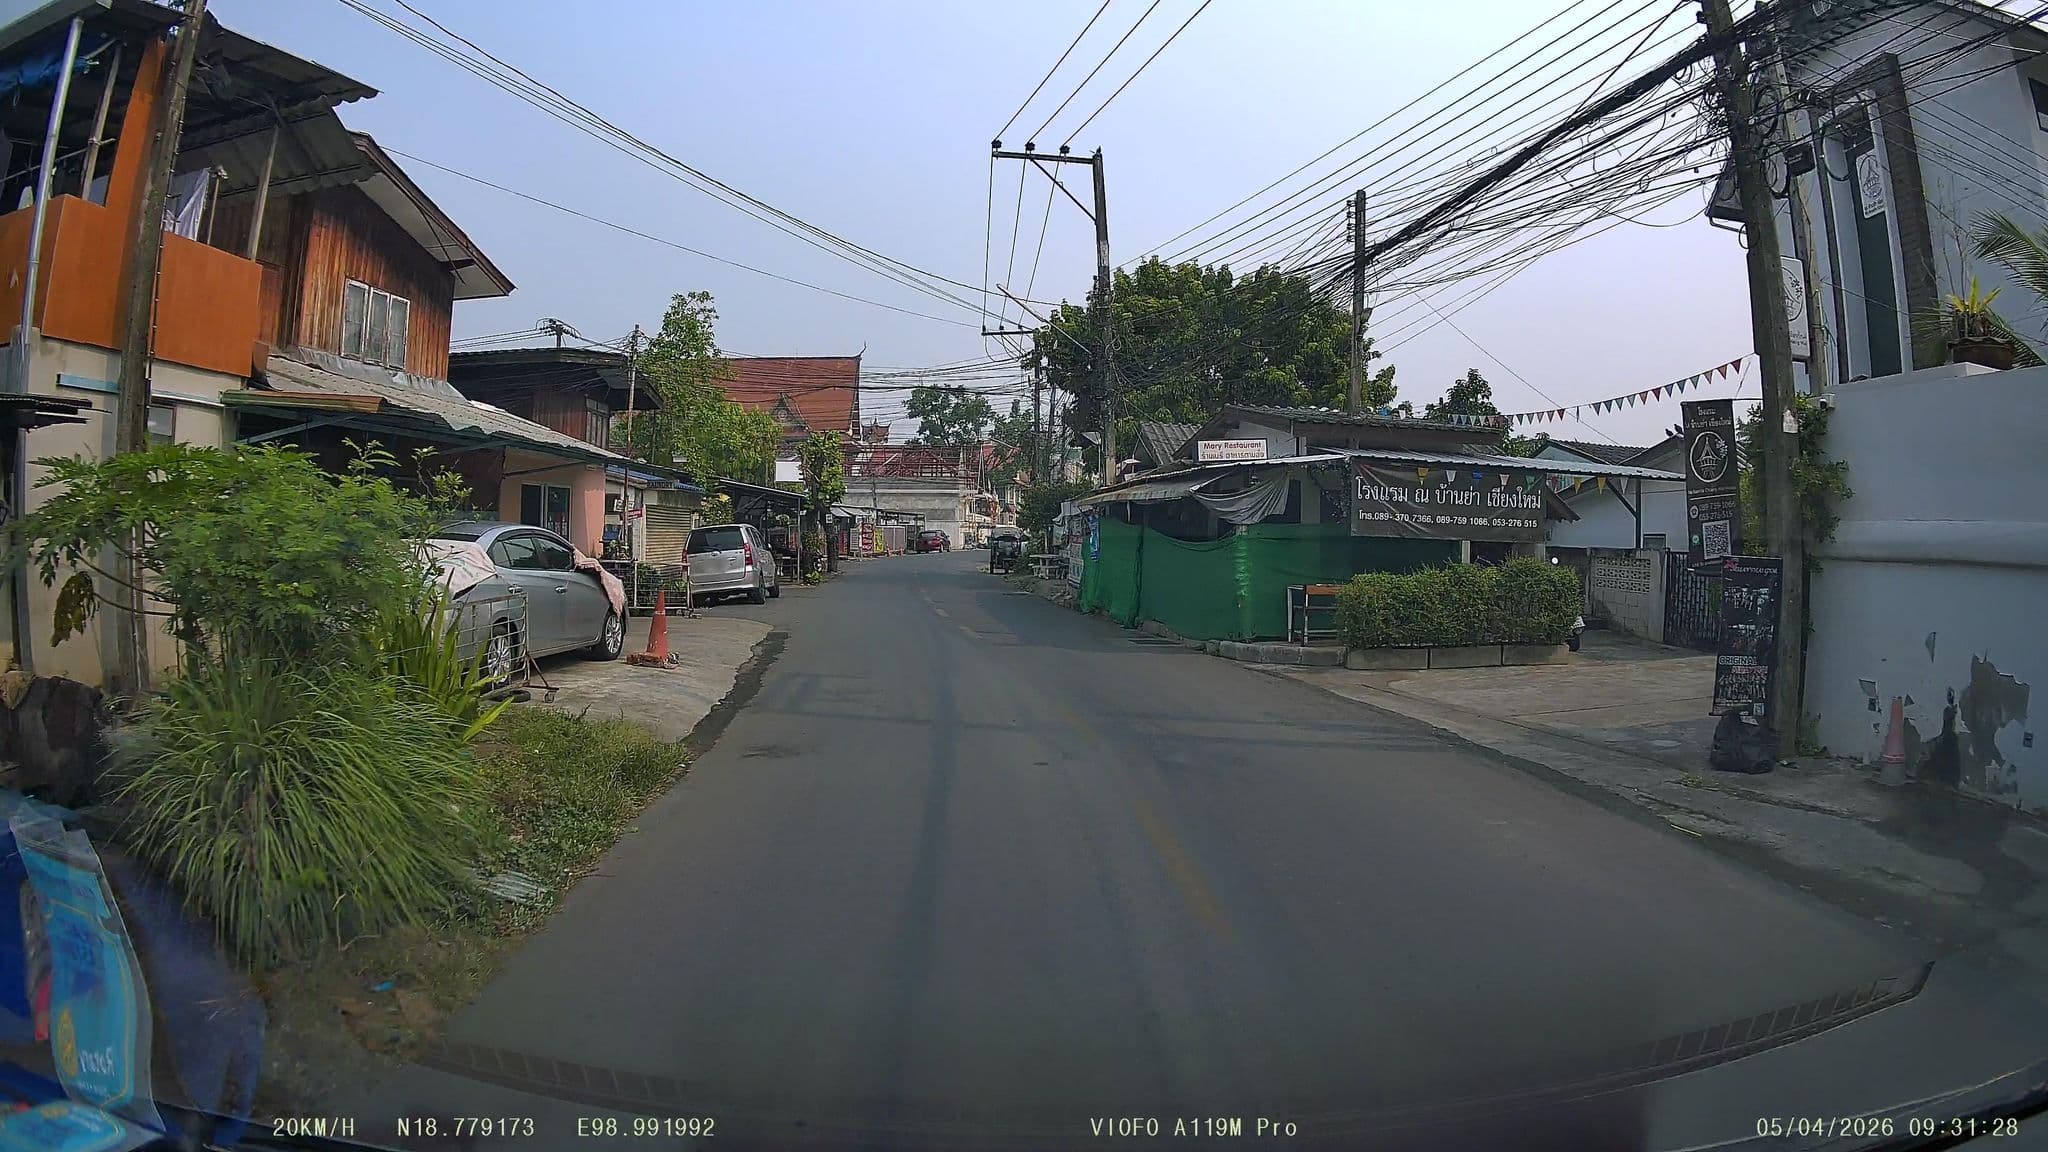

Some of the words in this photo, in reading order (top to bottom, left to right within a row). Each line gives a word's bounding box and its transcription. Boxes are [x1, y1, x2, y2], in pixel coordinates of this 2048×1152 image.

[1203, 442, 1223, 451] Mary
[1224, 441, 1261, 449] Restaurant
[1354, 475, 1409, 503] โรงแรม
[1415, 488, 1430, 504] ณ
[1435, 483, 1481, 506] บ้านย่า
[1436, 515, 1468, 525] 089-759
[1492, 517, 1522, 528] 053-276
[1524, 519, 1538, 528] 515
[1719, 655, 1758, 666] ORIGINAL
